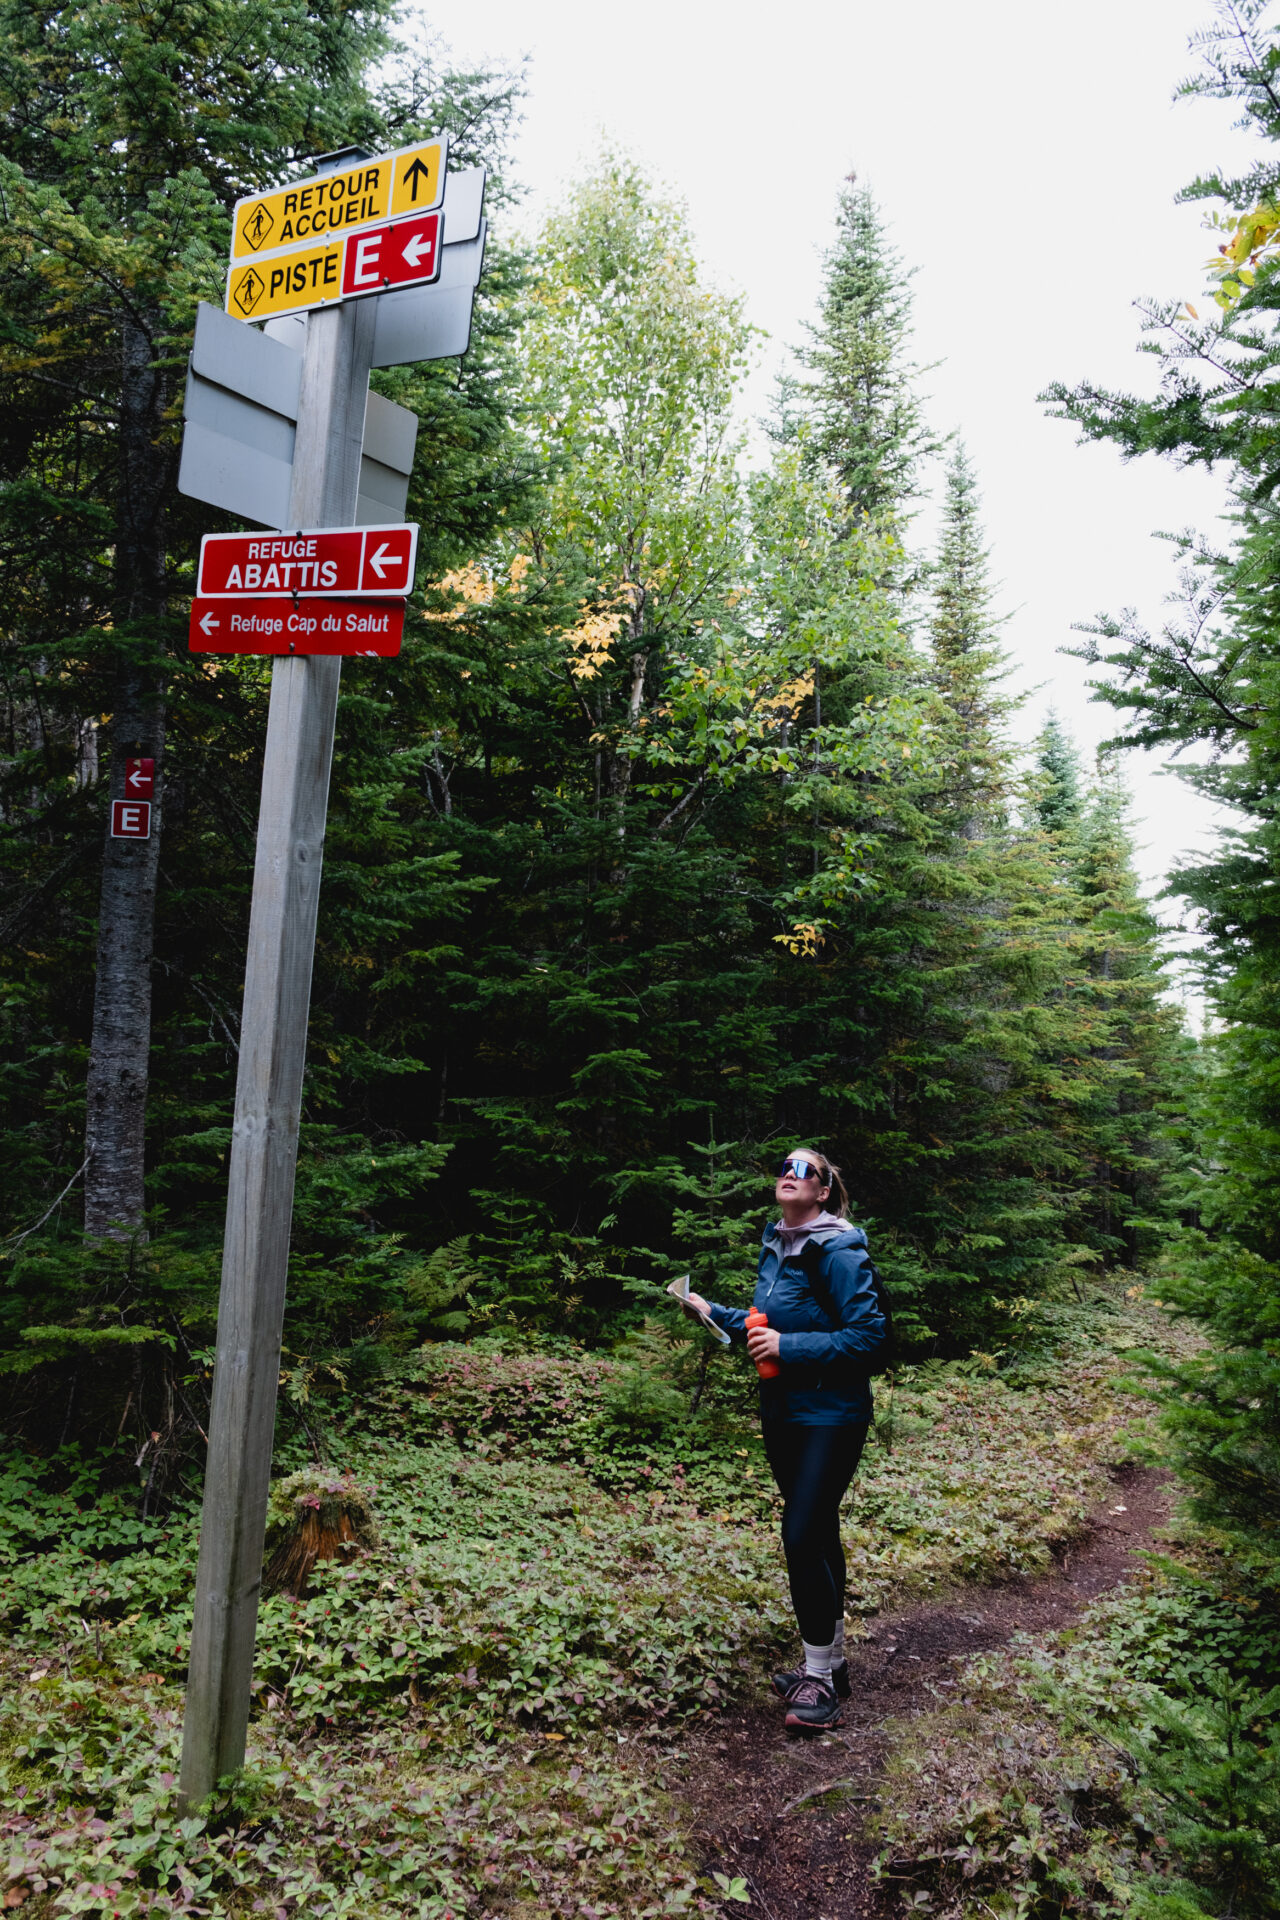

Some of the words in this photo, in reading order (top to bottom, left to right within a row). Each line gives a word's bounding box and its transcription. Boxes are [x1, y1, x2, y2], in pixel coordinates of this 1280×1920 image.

[284, 168, 380, 215] RETOUR
[279, 195, 380, 241] ACCUEIL
[270, 252, 338, 298] PISTE
[353, 235, 383, 286] E
[248, 540, 317, 559] REFUGE
[225, 560, 338, 589] ABATTIS
[230, 614, 283, 636] Refuge
[287, 613, 318, 635] Cap
[321, 613, 342, 632] du
[345, 613, 390, 633] Salut
[121, 807, 140, 831] E
